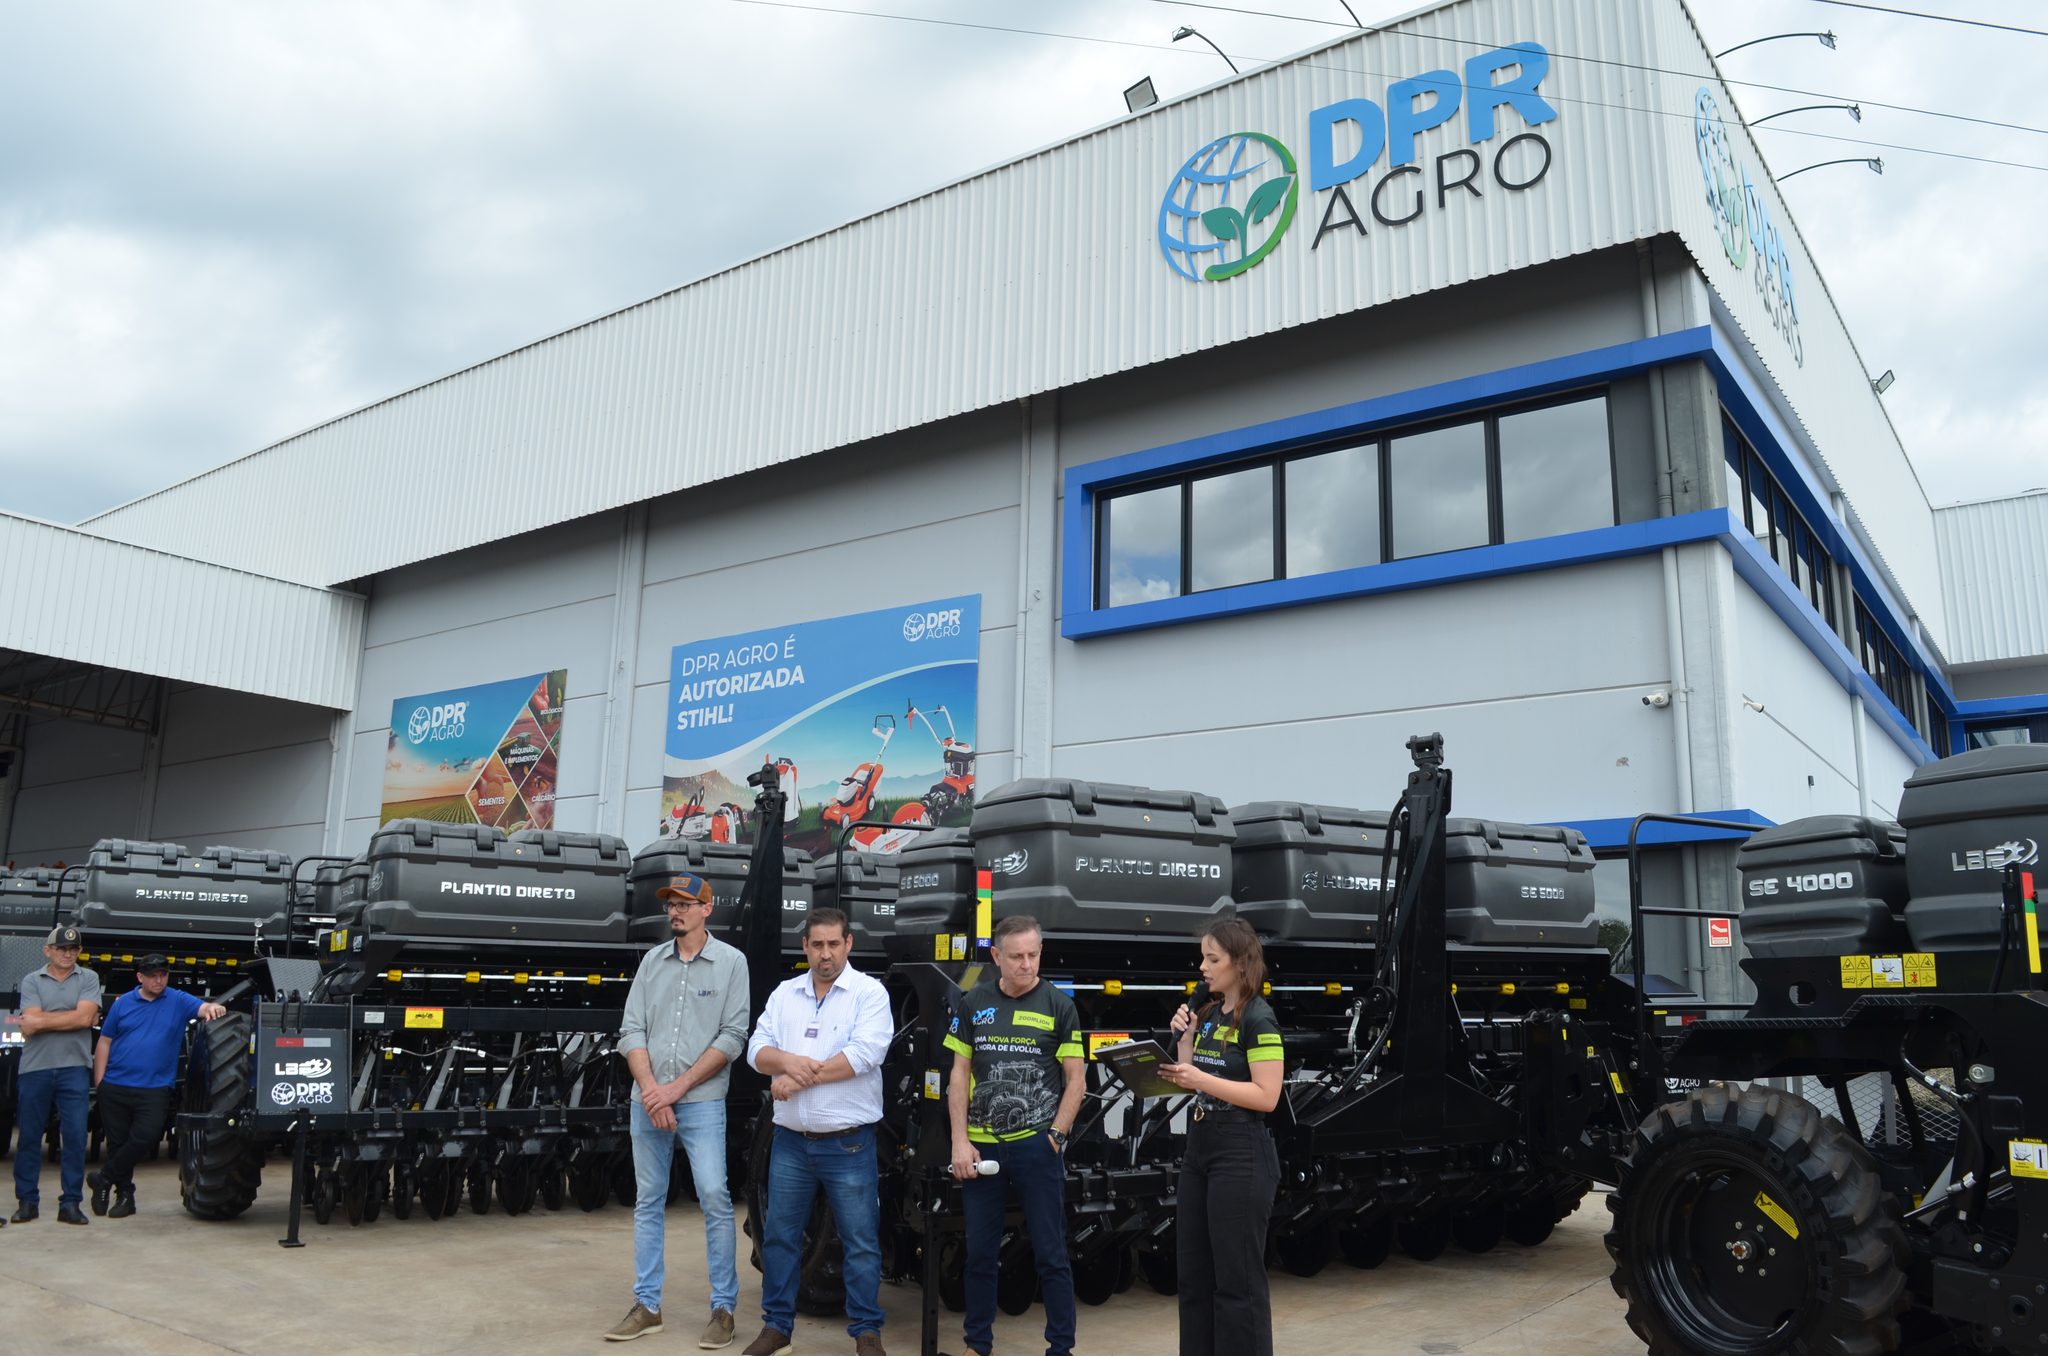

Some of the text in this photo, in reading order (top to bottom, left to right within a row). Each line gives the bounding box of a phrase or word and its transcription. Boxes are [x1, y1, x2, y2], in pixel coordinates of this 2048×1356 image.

[1309, 41, 1557, 192] DPR
[1311, 133, 1552, 250] AGRO
[926, 608, 961, 630] DPR
[926, 624, 961, 640] AGRO
[682, 633, 797, 677] DPR AGRO É
[678, 664, 806, 704] AUTORIZADA
[431, 701, 467, 728] DPR
[676, 703, 735, 731] STIHL!
[429, 723, 465, 742] AGRO
[478, 796, 506, 807] SEMENTES
[1076, 855, 1221, 879] PLANTIO DIRETO
[440, 881, 576, 900] PLANTIO DIRETO
[1520, 886, 1565, 900] SE 5000
[1749, 871, 1854, 897] SE 4000
[135, 888, 249, 904] PLANTIO DIRETO
[978, 938, 990, 947] RÉ
[1018, 1015, 1051, 1026] ZOOMLION
[988, 1035, 1010, 1044] NOVA
[1010, 1036, 1037, 1046] FORÇA
[998, 1044, 1009, 1052] DE
[296, 1082, 333, 1097] DPR
[297, 1094, 333, 1104] AGRO
